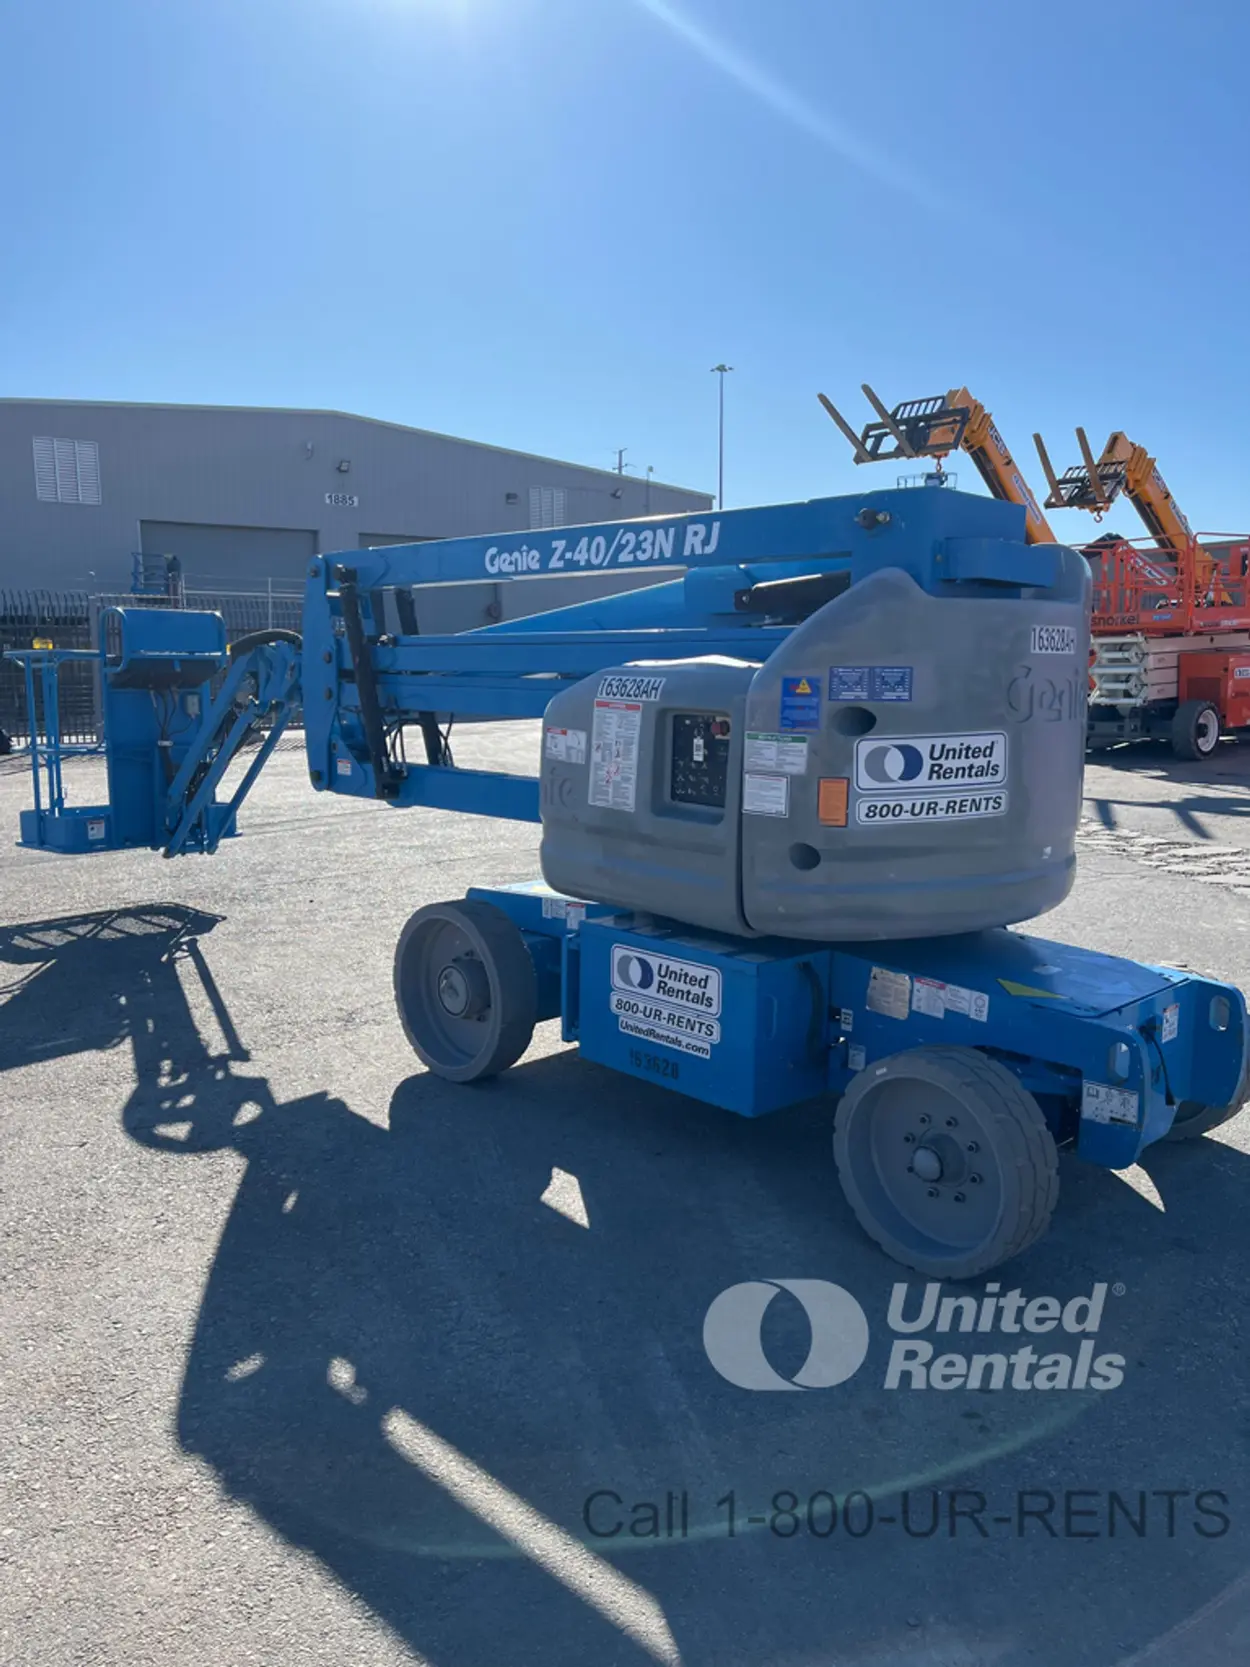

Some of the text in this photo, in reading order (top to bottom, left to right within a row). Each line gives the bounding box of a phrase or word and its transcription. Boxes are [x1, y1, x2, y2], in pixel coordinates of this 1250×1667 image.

[328, 495, 354, 506] 1885
[485, 521, 720, 574] Genie Z-40/23N RJ
[599, 677, 662, 700] 163628AH
[1007, 664, 1086, 724] Geni
[928, 741, 995, 762] United
[928, 760, 1000, 781] Rentals
[865, 796, 1003, 819] 800-UR-RENTS
[657, 963, 709, 989] United
[656, 980, 714, 1008] Rentals
[615, 998, 714, 1037] 800-UR-RENTS
[620, 1020, 709, 1056] UnitedRentals.com
